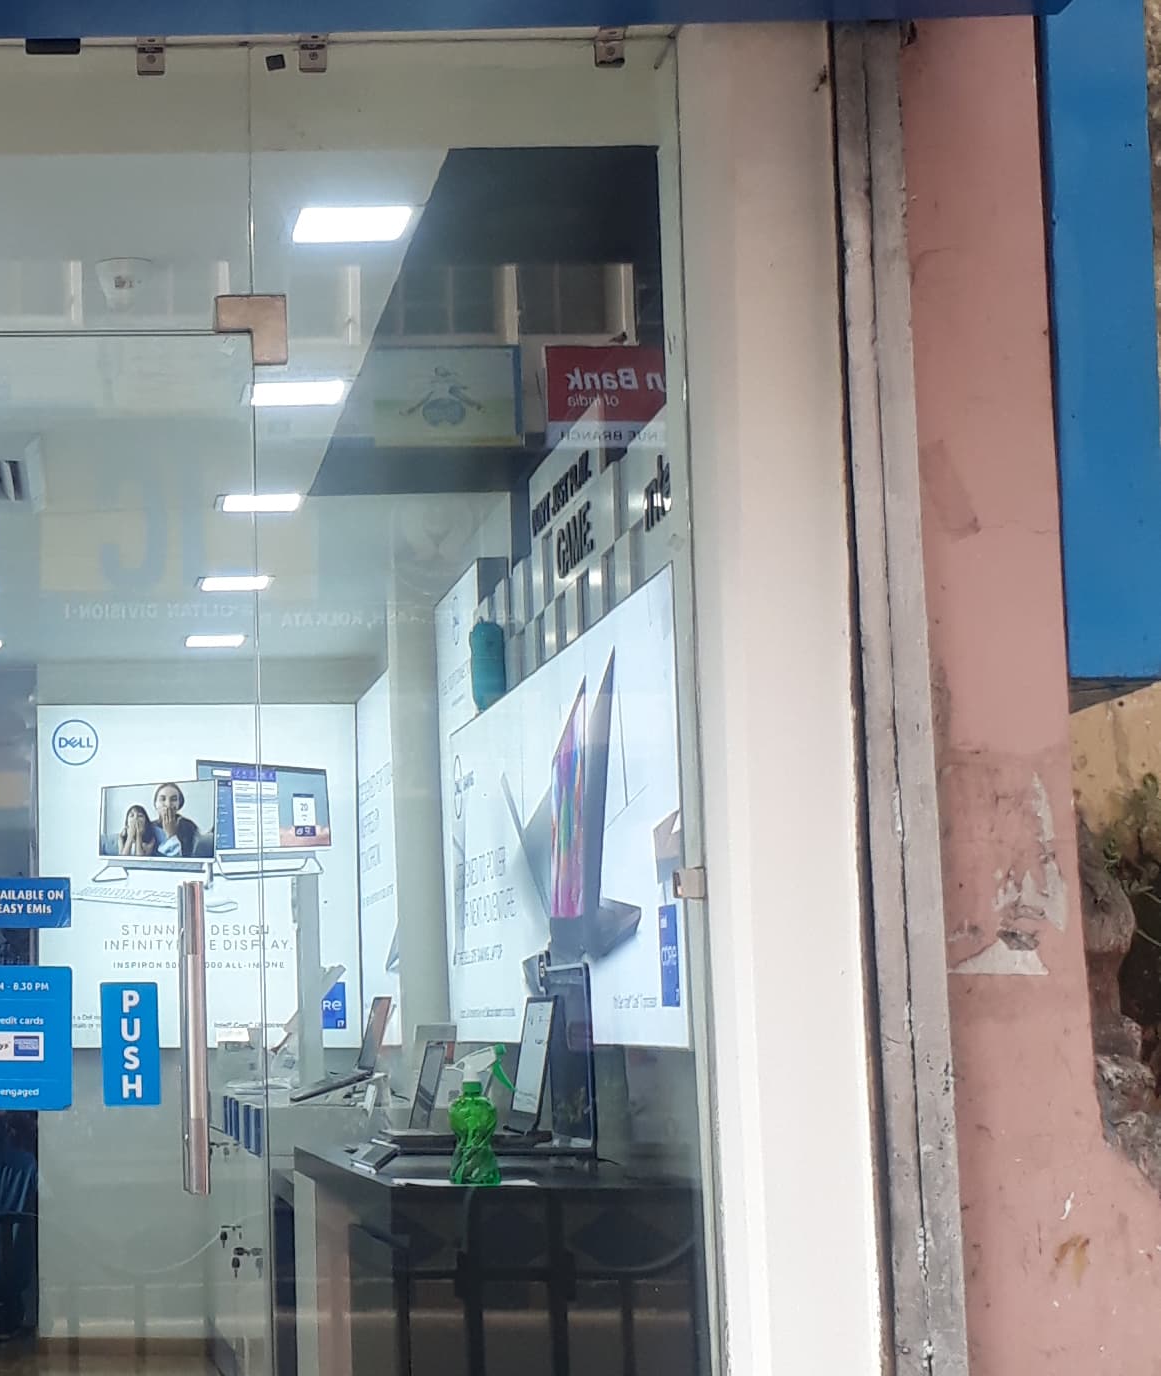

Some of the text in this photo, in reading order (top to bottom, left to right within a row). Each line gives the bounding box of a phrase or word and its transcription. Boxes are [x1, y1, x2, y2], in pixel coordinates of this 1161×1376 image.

[58, 735, 94, 750] DELL
[46, 889, 64, 901] ON
[26, 903, 53, 915] EMIs
[121, 923, 185, 936] STUNN
[223, 939, 294, 952] DISPAY.
[34, 982, 50, 991] PM
[19, 1015, 44, 1026] cards
[120, 990, 144, 1100] PUSH
[0, 1086, 40, 1099] engaged
